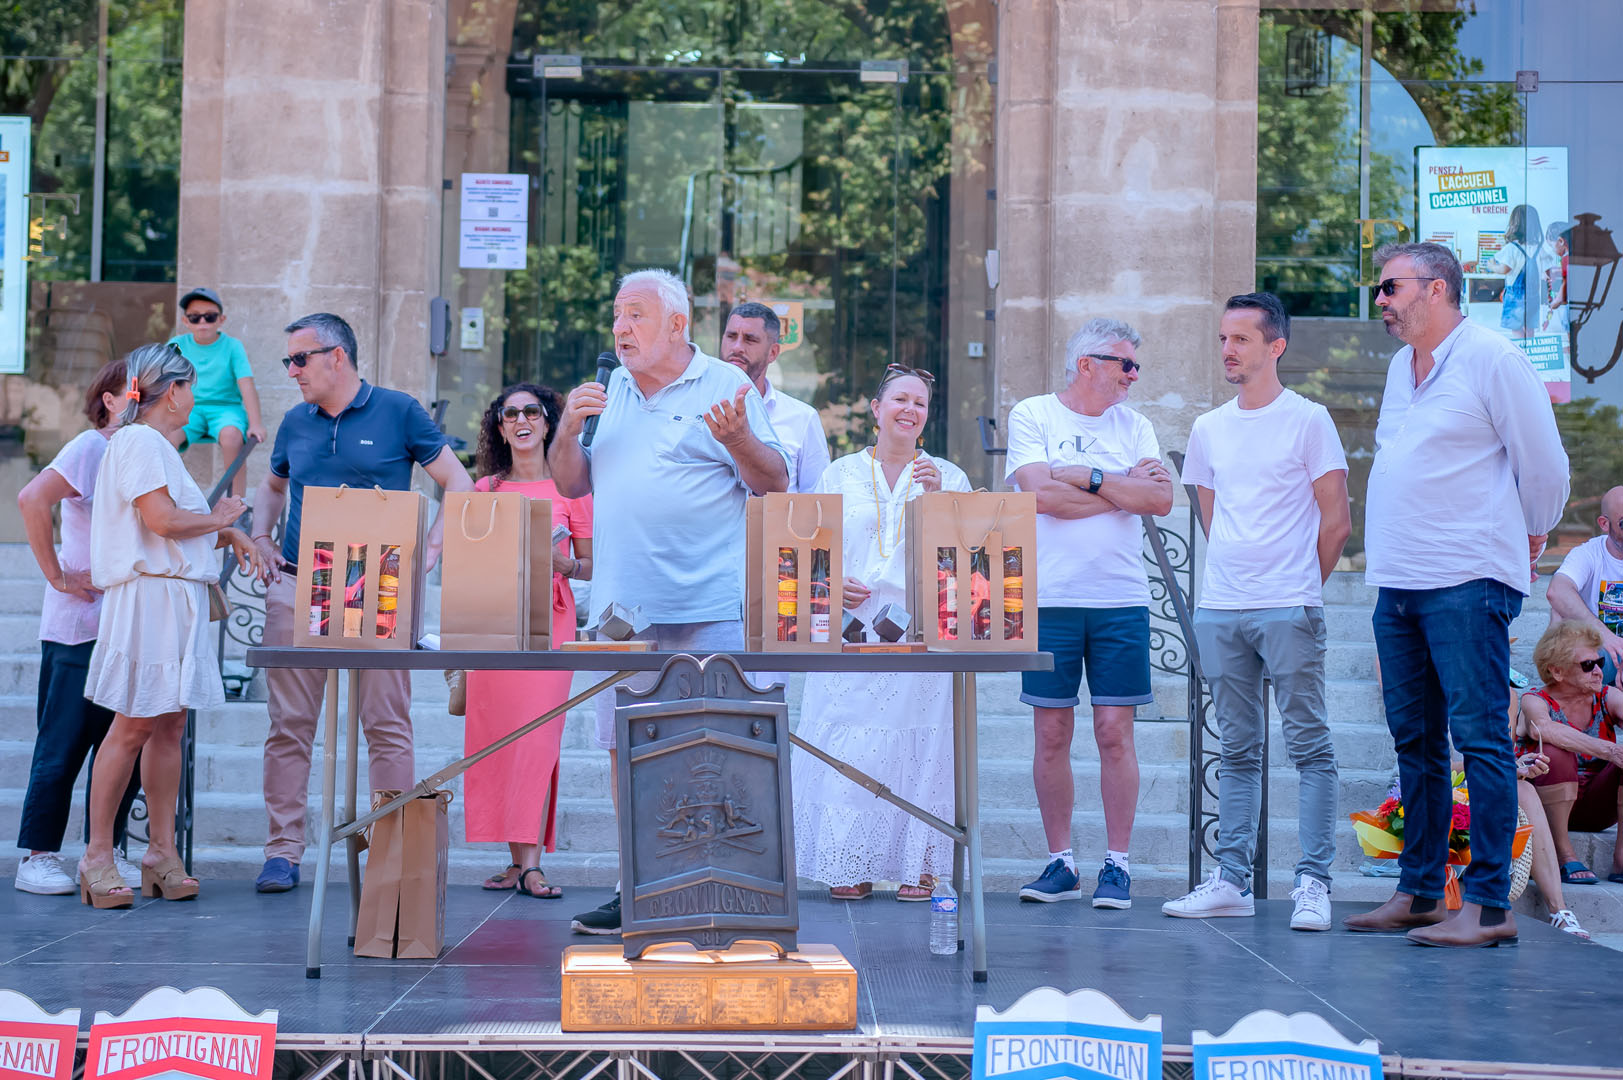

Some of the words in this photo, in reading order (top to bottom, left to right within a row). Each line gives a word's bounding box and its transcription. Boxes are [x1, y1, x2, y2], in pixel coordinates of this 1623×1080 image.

[1428, 166, 1457, 175] PENSEZ
[1440, 172, 1493, 190] L'ACCUEIL
[1432, 189, 1506, 208] OCCASIONNEL
[1472, 206, 1481, 214] EN
[648, 883, 771, 918] FRONTIGNAN
[0, 1041, 55, 1074] NAN
[103, 1034, 259, 1075] FRONTIGNAN
[990, 1038, 1145, 1080] FRONTIGNAN
[1211, 1059, 1367, 1080] FRONTIG
